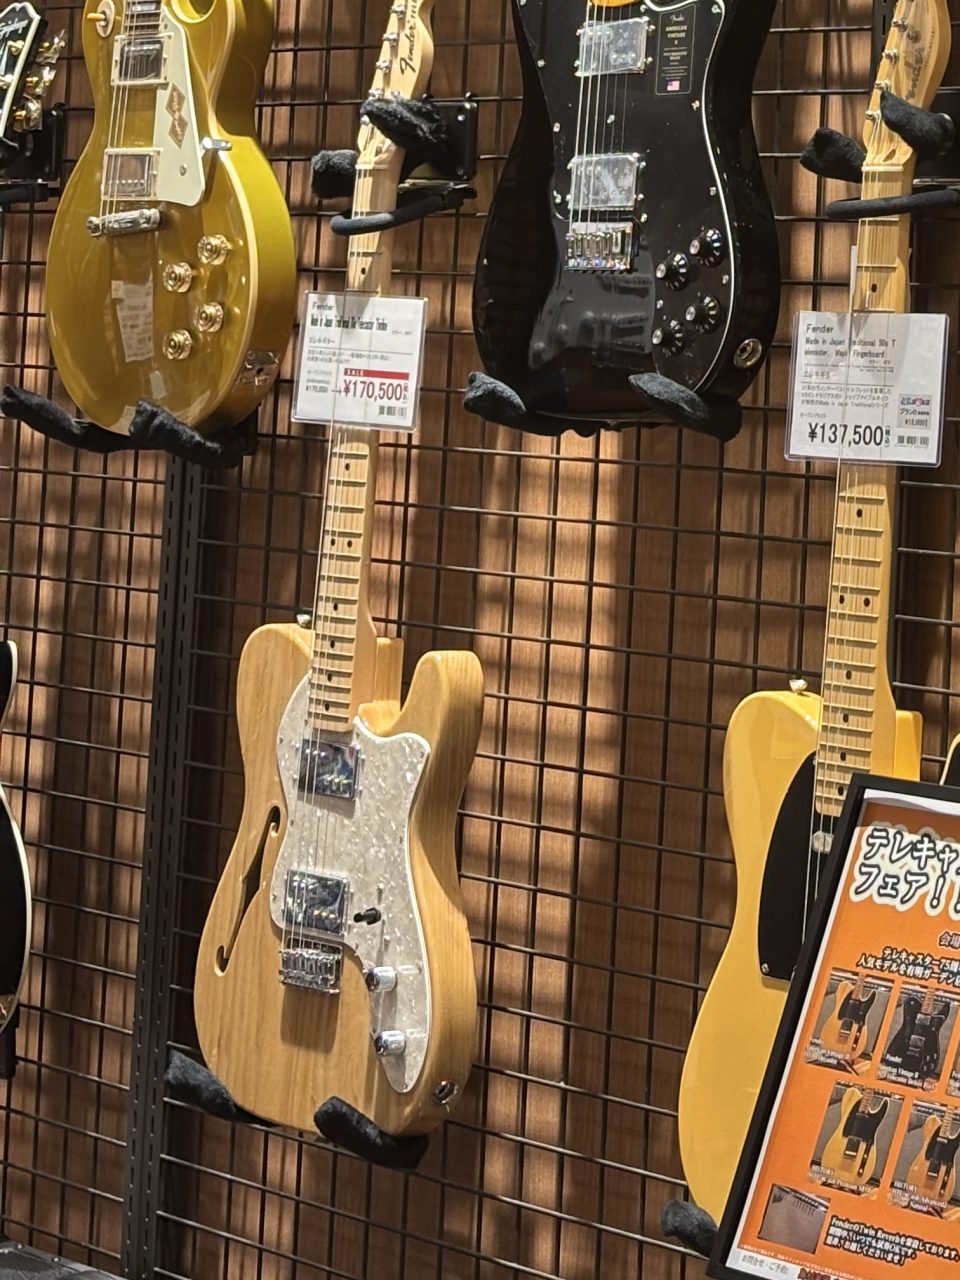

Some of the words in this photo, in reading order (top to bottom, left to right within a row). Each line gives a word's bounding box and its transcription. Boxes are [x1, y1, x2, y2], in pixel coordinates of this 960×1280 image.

[400, 20, 416, 75] Fender
[312, 302, 334, 311] Fender
[806, 324, 834, 333] Fender
[892, 339, 896, 347] T
[853, 350, 885, 358] Fingerboard
[344, 379, 403, 402] ¥170,500
[808, 423, 883, 447] ¥137,500
